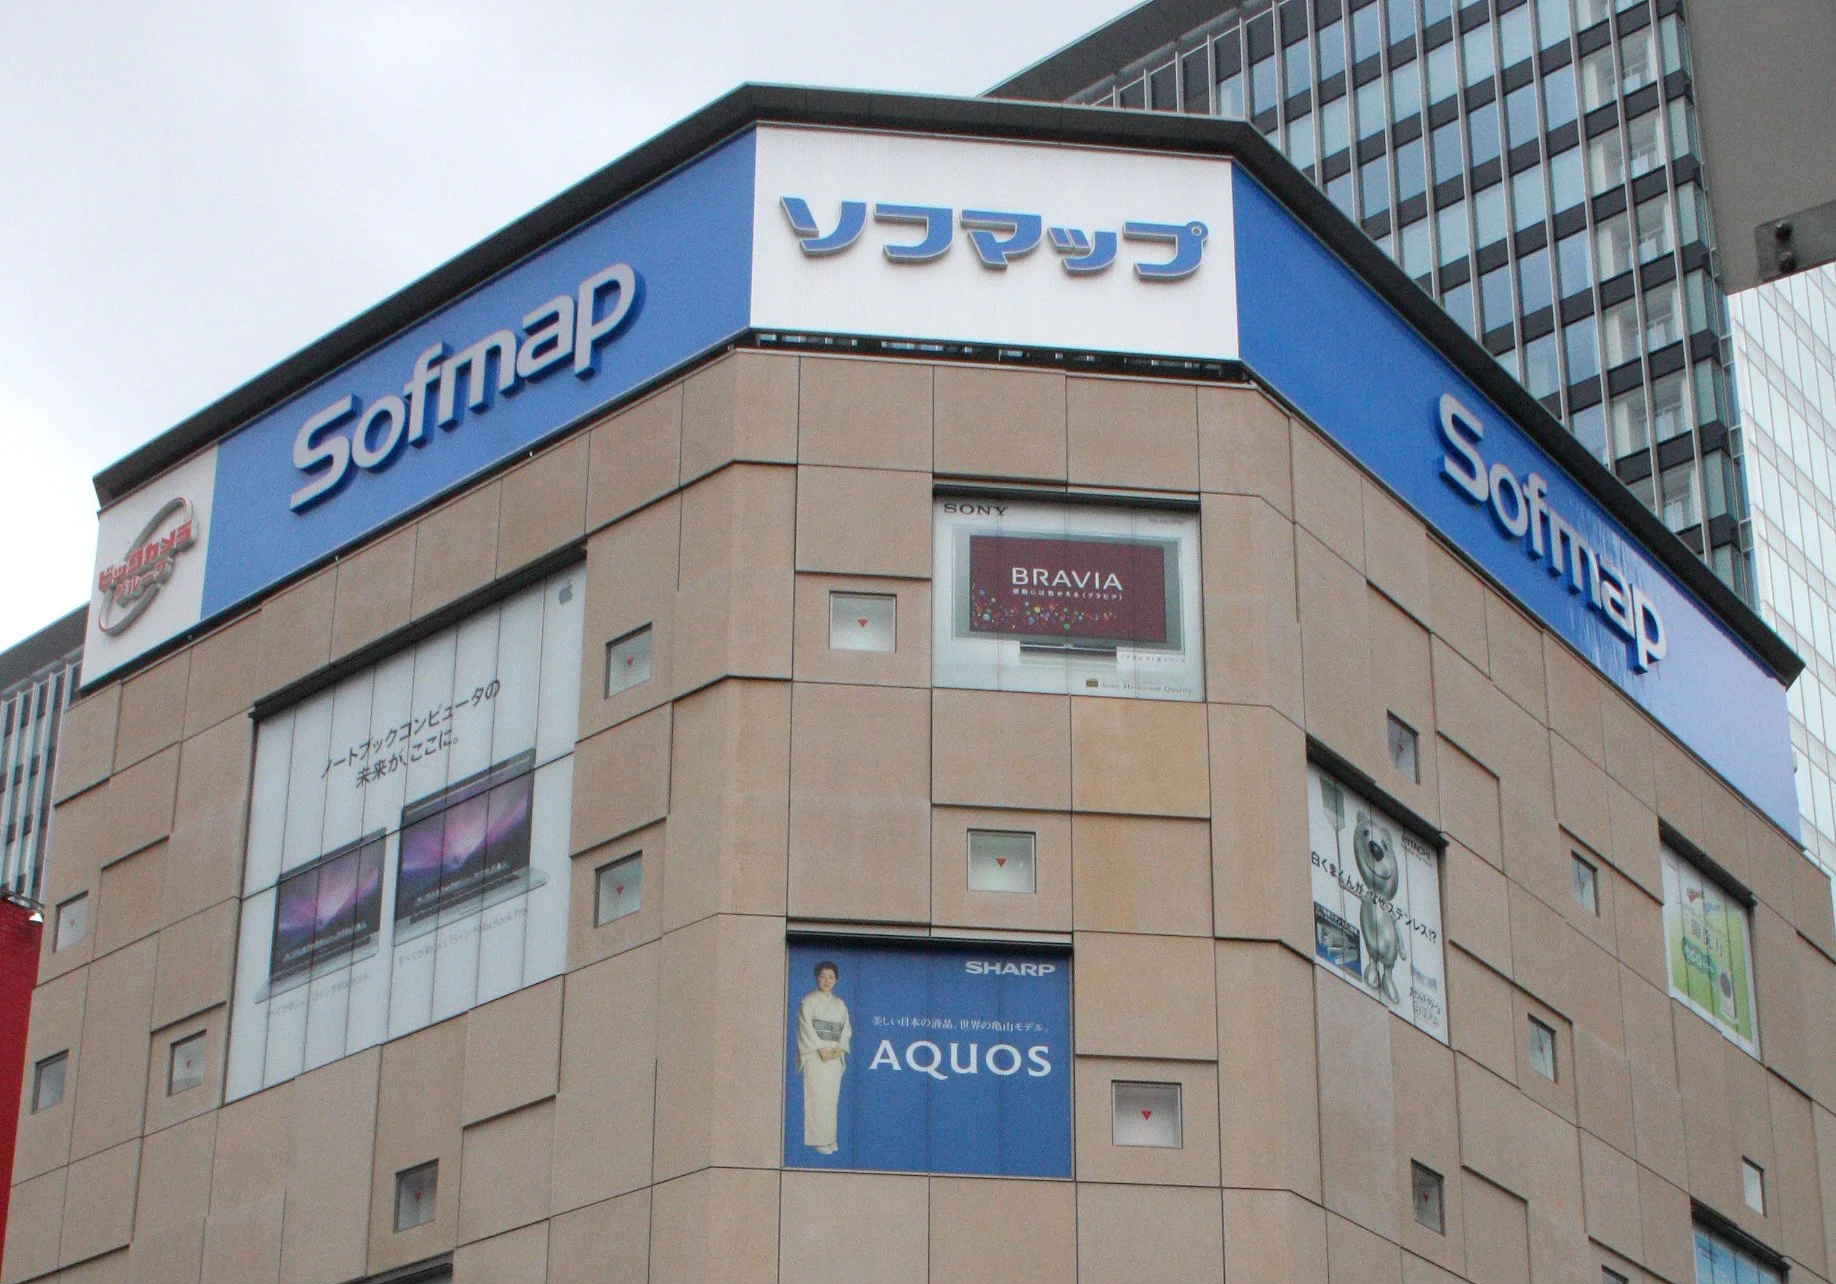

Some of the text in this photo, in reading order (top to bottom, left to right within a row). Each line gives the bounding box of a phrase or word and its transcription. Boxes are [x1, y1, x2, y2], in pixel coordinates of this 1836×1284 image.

[780, 195, 1209, 281] ソフマップ
[289, 262, 642, 512] Sofmap
[943, 503, 1008, 516] SONY
[1435, 393, 1668, 673] Sofmap
[1011, 567, 1123, 591] BRAVIA
[320, 678, 501, 781] ノートブックコンピュータの
[965, 961, 1056, 976] SHARP
[868, 1039, 1052, 1081] AQUOS
